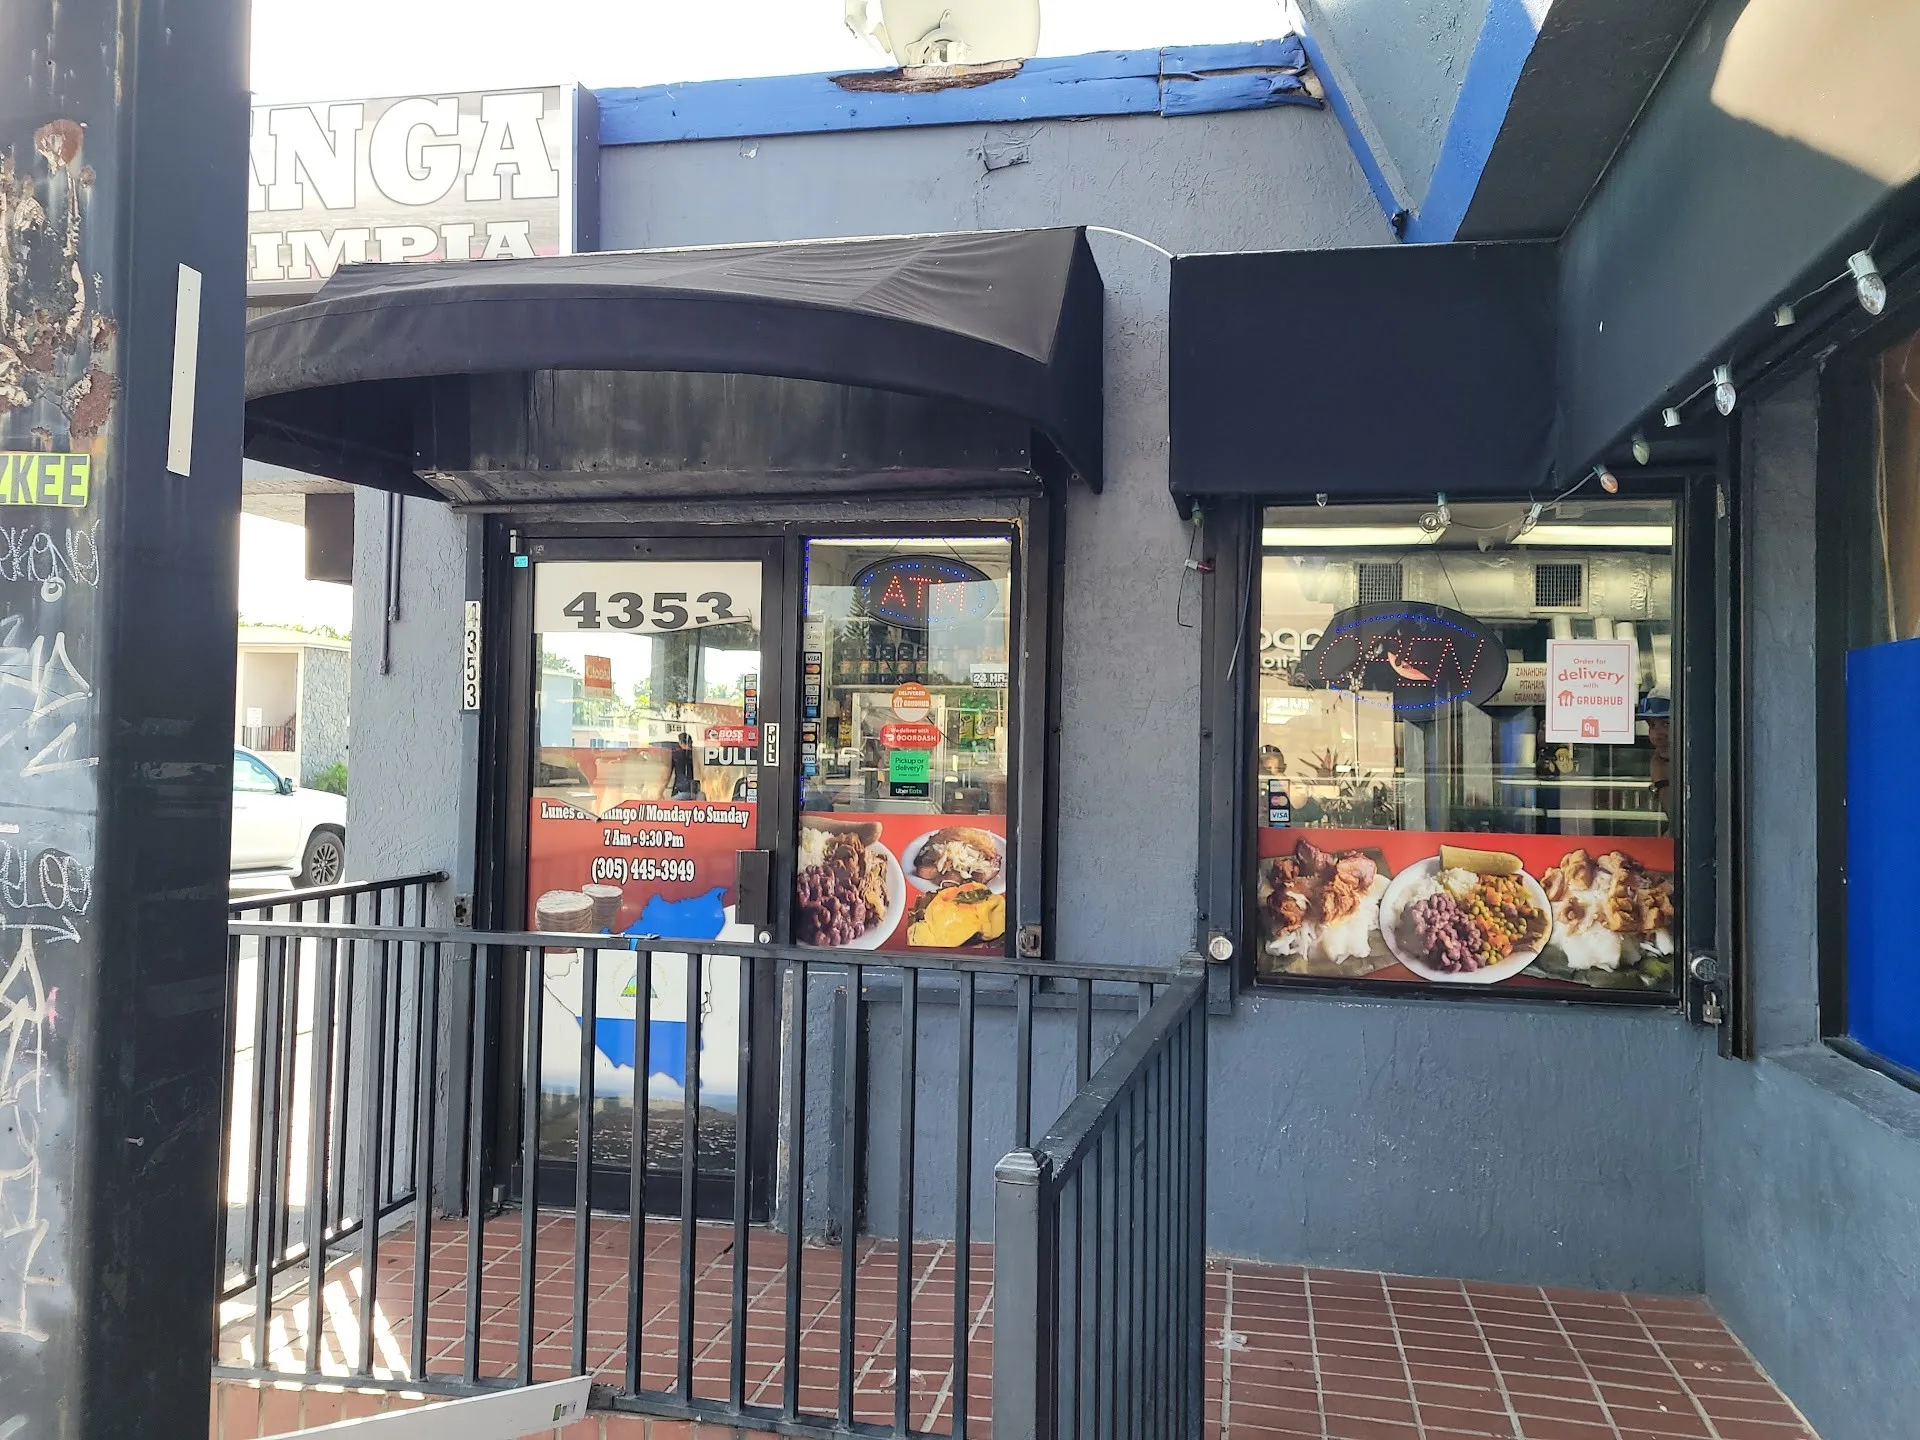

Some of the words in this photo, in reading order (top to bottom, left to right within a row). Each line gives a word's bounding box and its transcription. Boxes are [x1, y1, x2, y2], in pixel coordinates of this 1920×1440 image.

[249, 92, 559, 212] NGA
[247, 220, 536, 281] IMPIA
[880, 575, 966, 612] ATM
[563, 591, 735, 630] 4353
[466, 602, 479, 708] 4353
[1319, 634, 1485, 689] OPEN
[973, 673, 988, 683] 24
[1558, 667, 1625, 685] delivery
[1577, 696, 1624, 706] GRUBHUB
[719, 729, 744, 738] BOSS
[767, 726, 776, 763] PULL
[704, 747, 758, 765] PULL
[895, 757, 917, 765] Pickup
[895, 765, 924, 773] delivery?
[541, 802, 575, 819] Lunes
[645, 804, 693, 827] Monday
[693, 807, 706, 822] to
[706, 807, 749, 829] Sunday
[603, 829, 611, 846] 7
[612, 830, 632, 847] Am
[639, 830, 663, 847] 9:30
[663, 831, 684, 848] Pm
[591, 857, 628, 884] (305)
[630, 858, 695, 882] 445-3949
